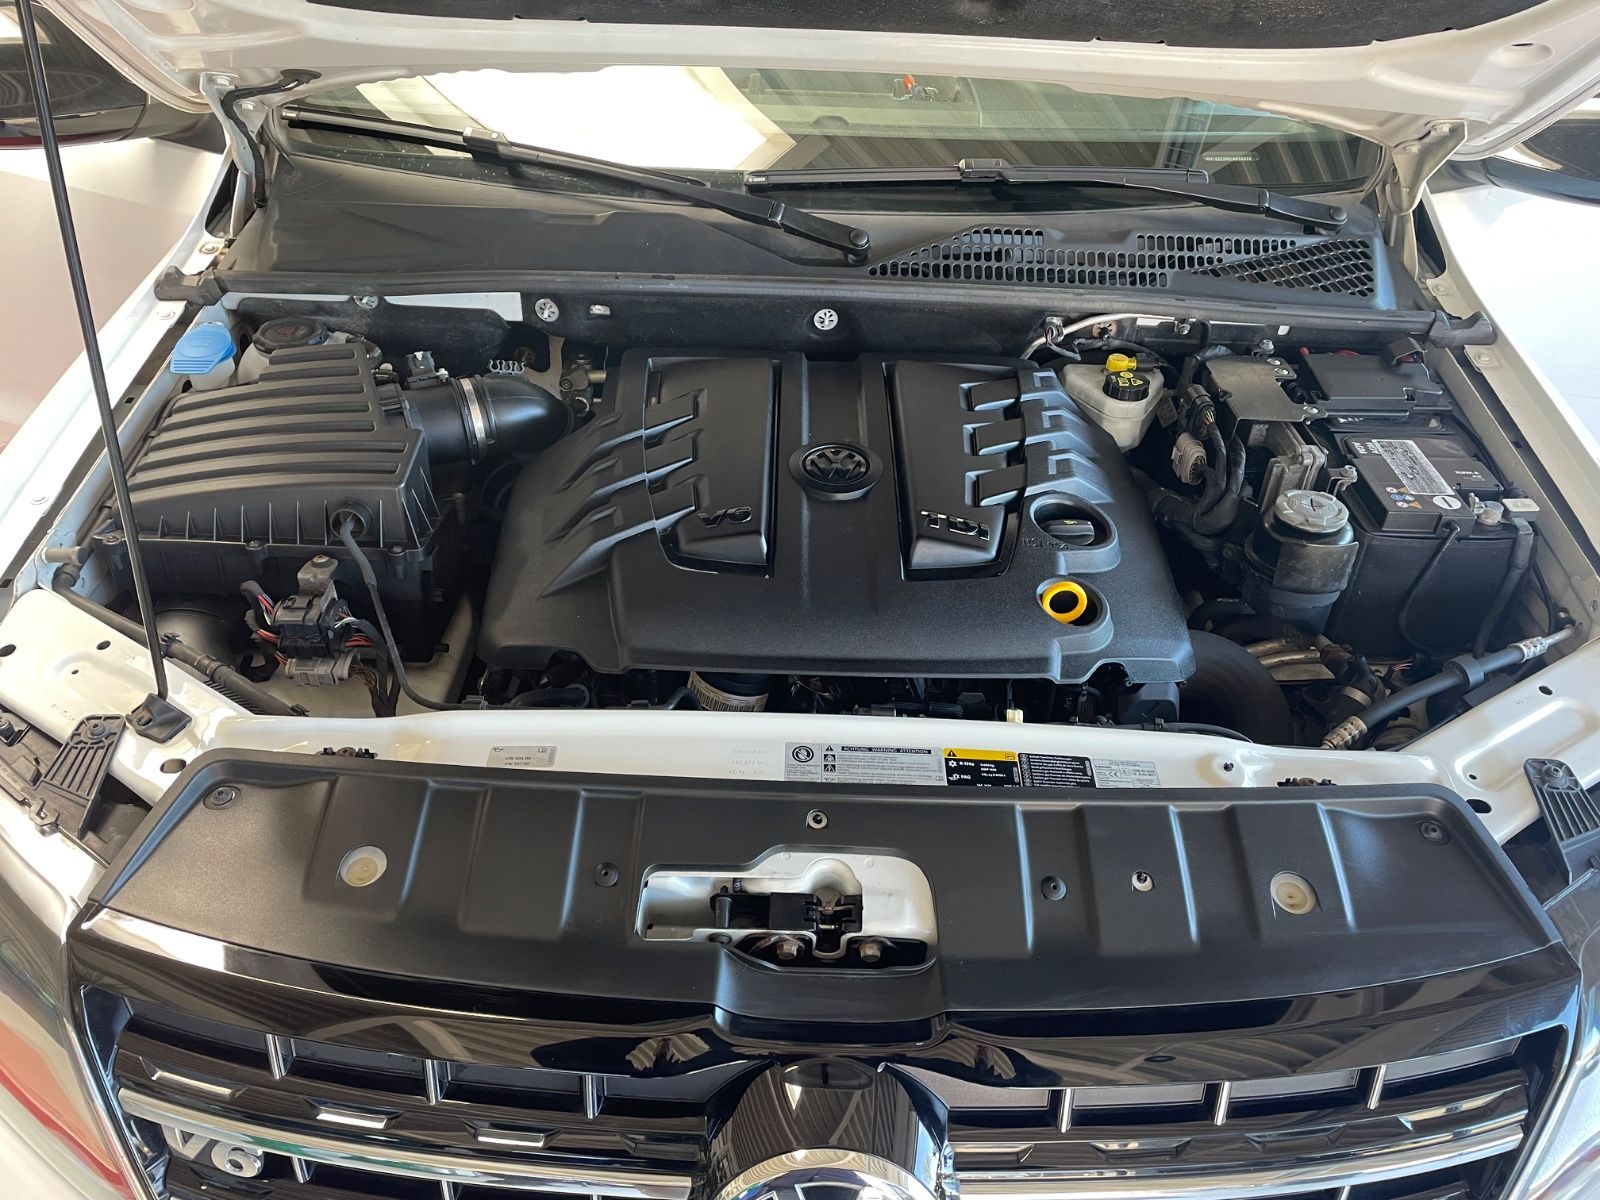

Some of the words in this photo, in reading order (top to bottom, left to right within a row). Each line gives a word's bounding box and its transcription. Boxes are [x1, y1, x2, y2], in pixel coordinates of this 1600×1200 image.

[697, 506, 752, 529] V6
[920, 510, 990, 541] TDI
[161, 1124, 263, 1178] V6
